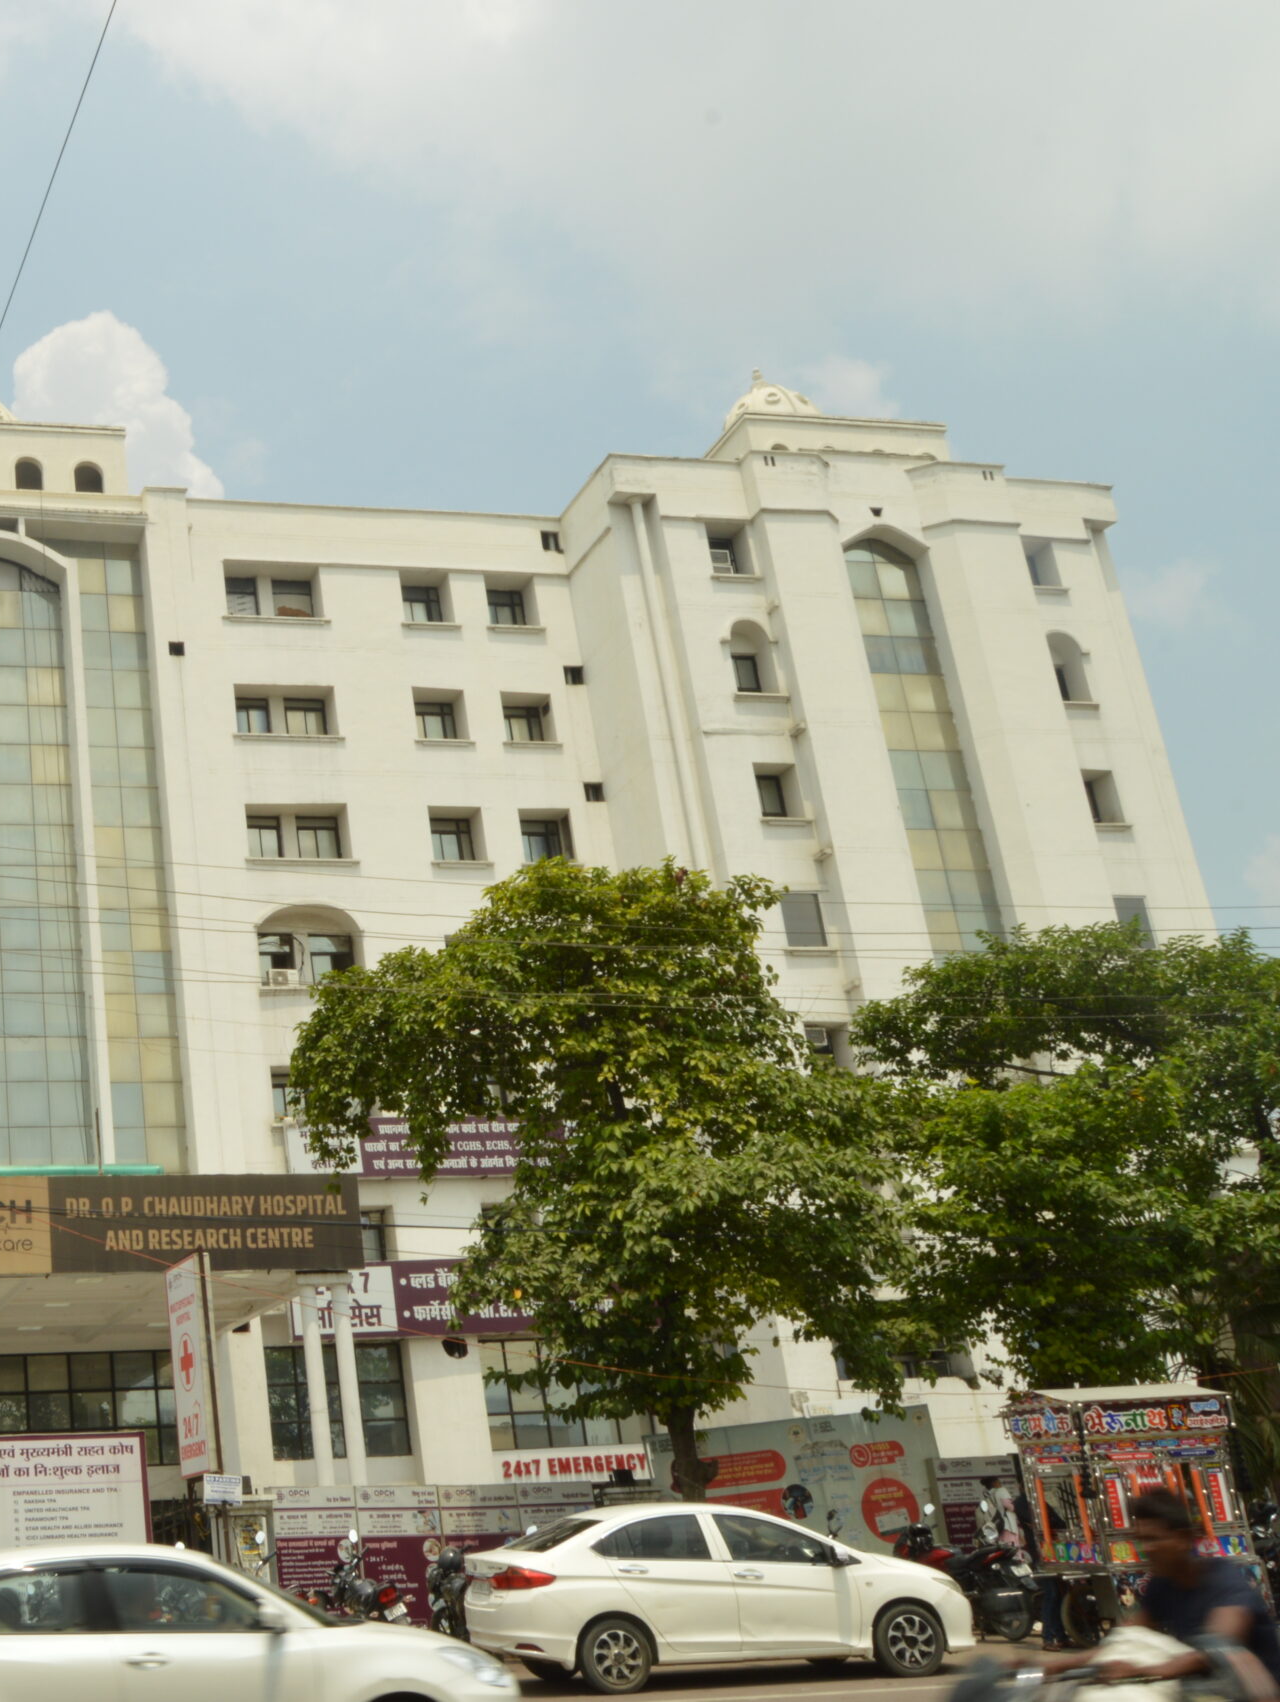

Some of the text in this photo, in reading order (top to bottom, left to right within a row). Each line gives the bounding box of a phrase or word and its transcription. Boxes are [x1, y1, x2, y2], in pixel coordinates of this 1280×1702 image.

[65, 1197, 97, 1218] DR.
[144, 1195, 255, 1217] CHAUDHARY
[259, 1194, 348, 1216] HOSPITAL
[105, 1227, 315, 1251] AND RESEARCH CENTRE
[359, 1272, 370, 1293] 7
[409, 1274, 435, 1288] ब्लड
[20, 1443, 73, 1461] मुख्यमंत्री
[77, 1446, 104, 1457] राहत
[108, 1442, 134, 1456] कोष
[14, 1467, 30, 1478] का
[86, 1464, 120, 1478] इलाज
[502, 1453, 647, 1479] 24x7 EMERGENCY
[12, 1489, 53, 1497] EMPANELLED
